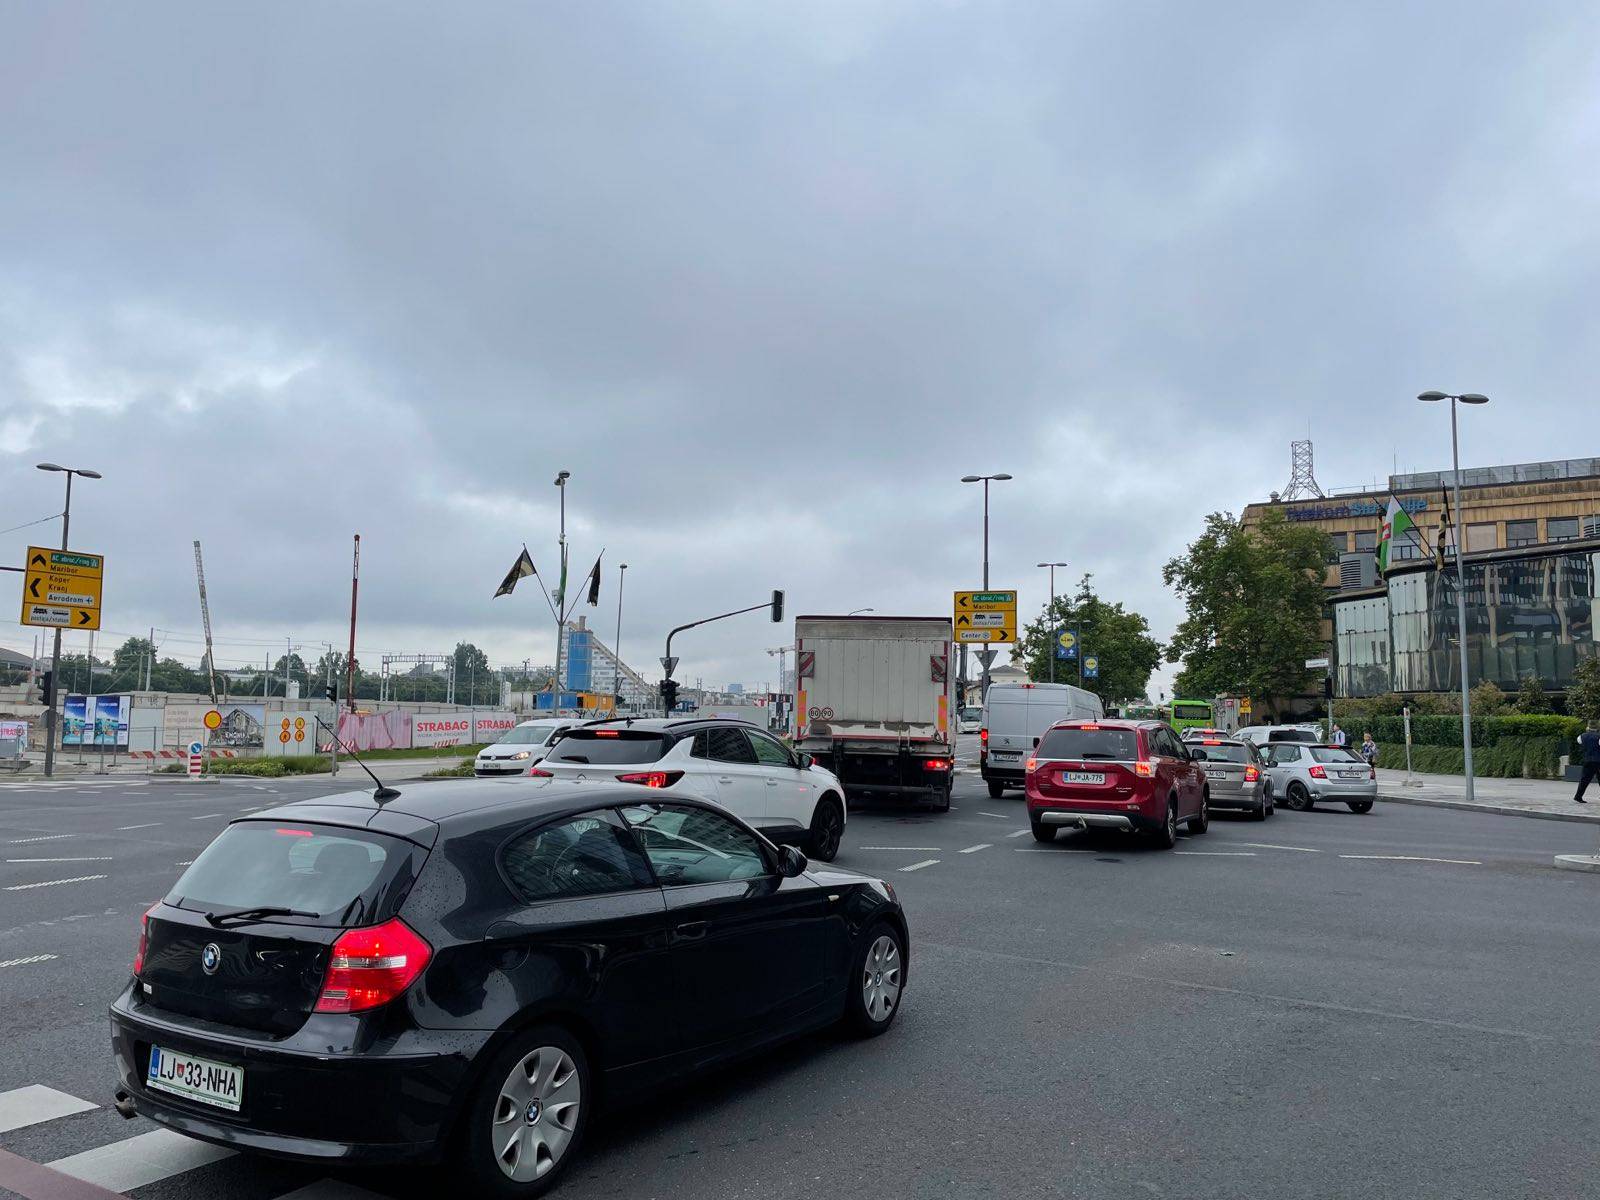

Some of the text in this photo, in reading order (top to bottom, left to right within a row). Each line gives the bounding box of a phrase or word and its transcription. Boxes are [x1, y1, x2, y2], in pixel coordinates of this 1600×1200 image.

[50, 564, 80, 574] Maribor
[49, 575, 71, 584] Koper
[48, 584, 68, 593] Kranj
[417, 720, 469, 732] STRABAG
[1081, 774, 1103, 782] JA-775
[160, 1054, 176, 1080] LJ
[184, 1061, 237, 1098] 33-NHA
